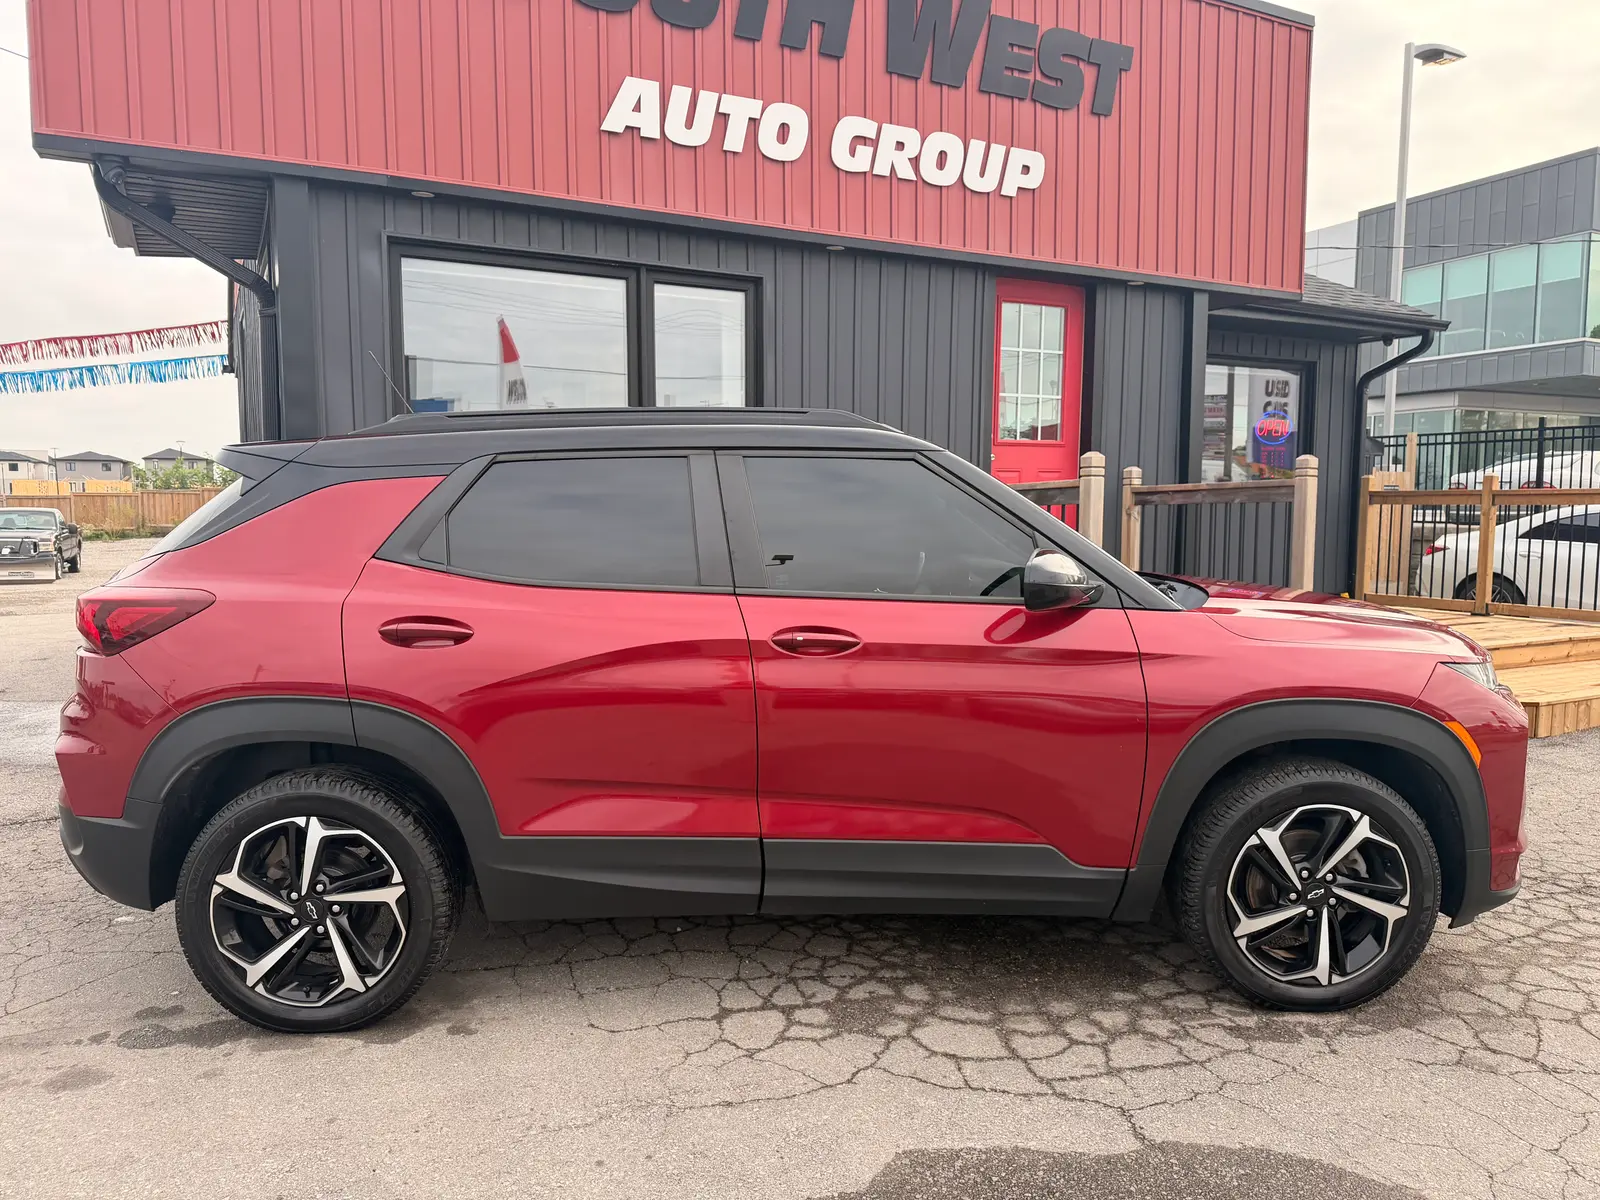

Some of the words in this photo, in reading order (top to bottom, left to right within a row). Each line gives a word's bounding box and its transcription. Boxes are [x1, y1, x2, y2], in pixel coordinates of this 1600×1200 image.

[886, 0, 1135, 117] WEST
[600, 75, 809, 162] AUTO
[831, 115, 1046, 198] GROUP
[1257, 419, 1290, 437] OPEN
